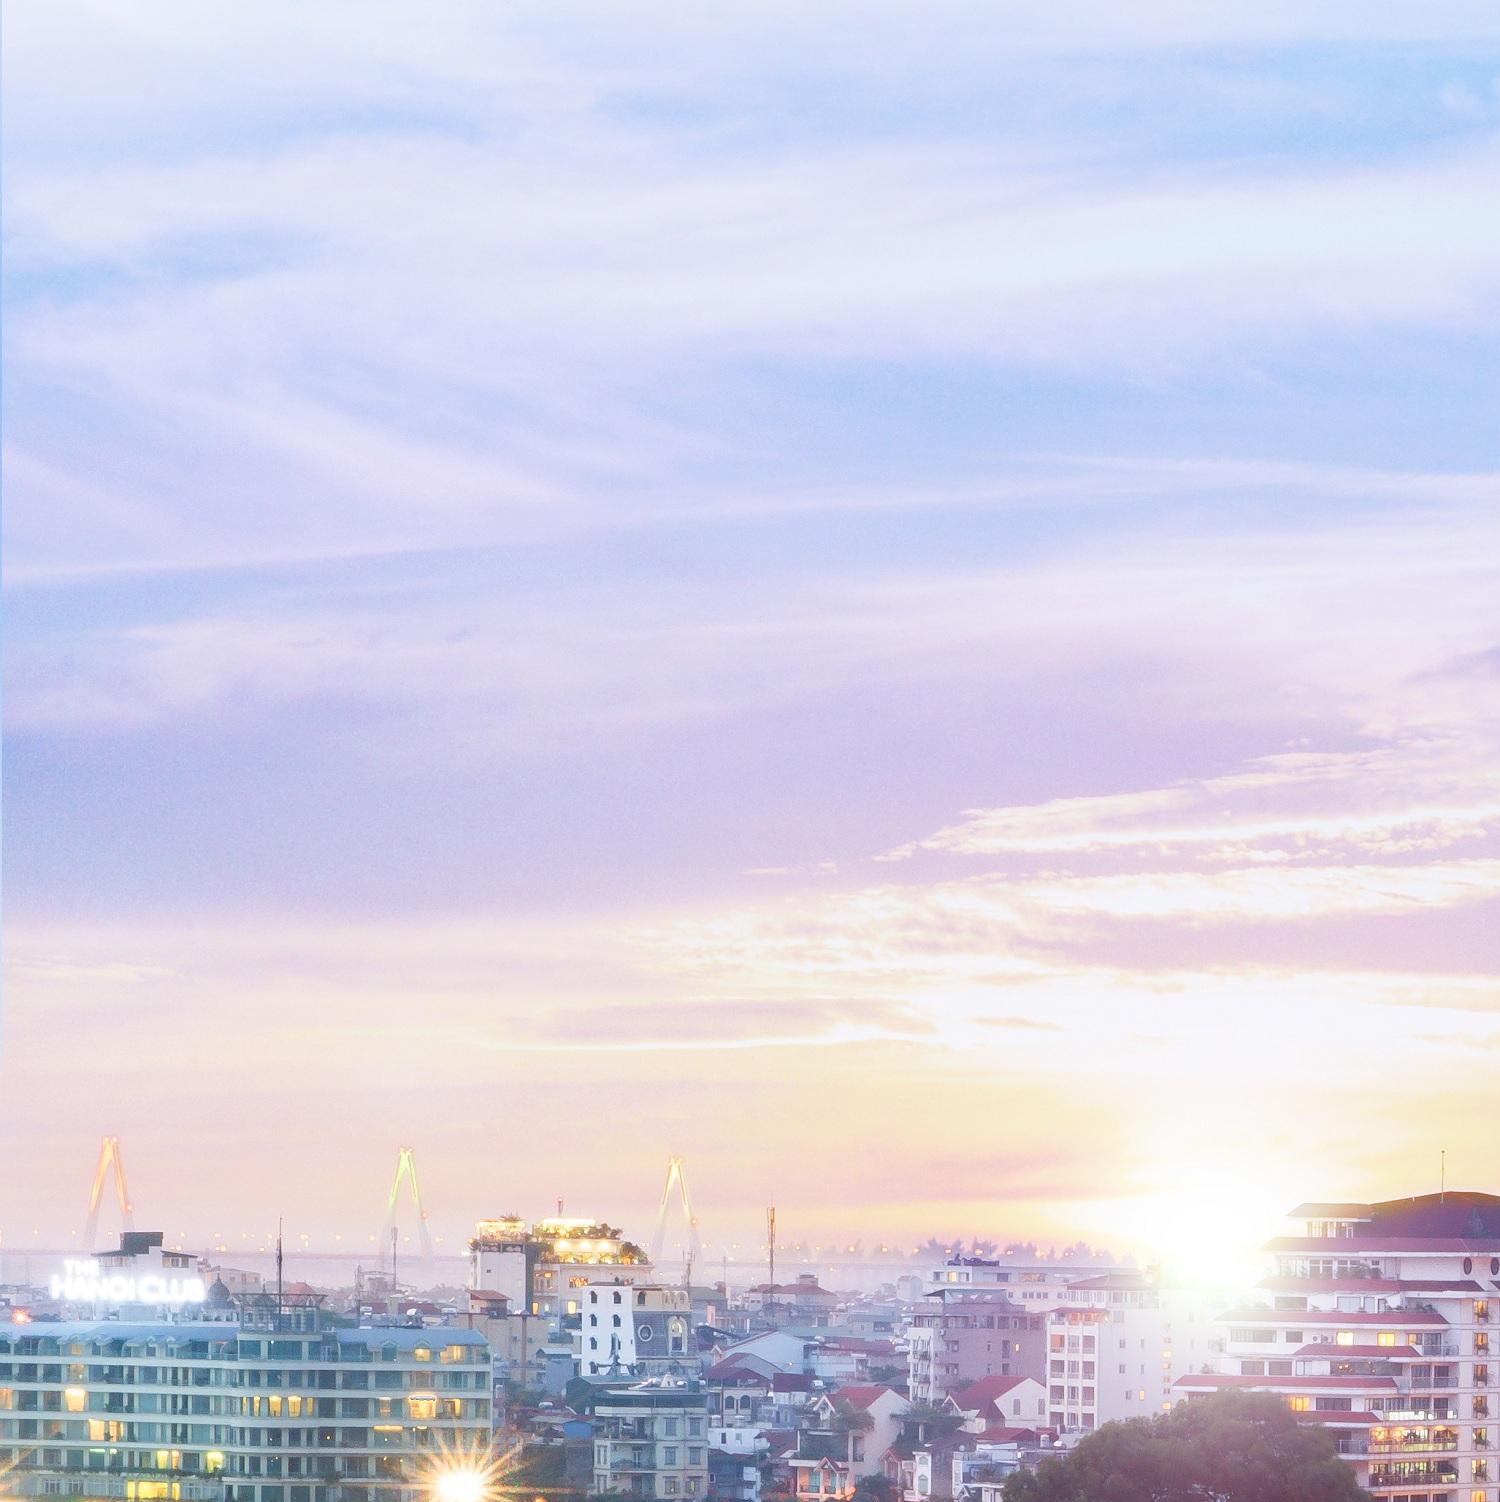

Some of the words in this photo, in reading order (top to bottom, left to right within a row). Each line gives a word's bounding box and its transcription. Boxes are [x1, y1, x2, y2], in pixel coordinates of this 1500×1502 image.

[64, 1258, 100, 1276] THE
[50, 1274, 136, 1301] HANOI
[137, 1273, 206, 1302] CLUB
